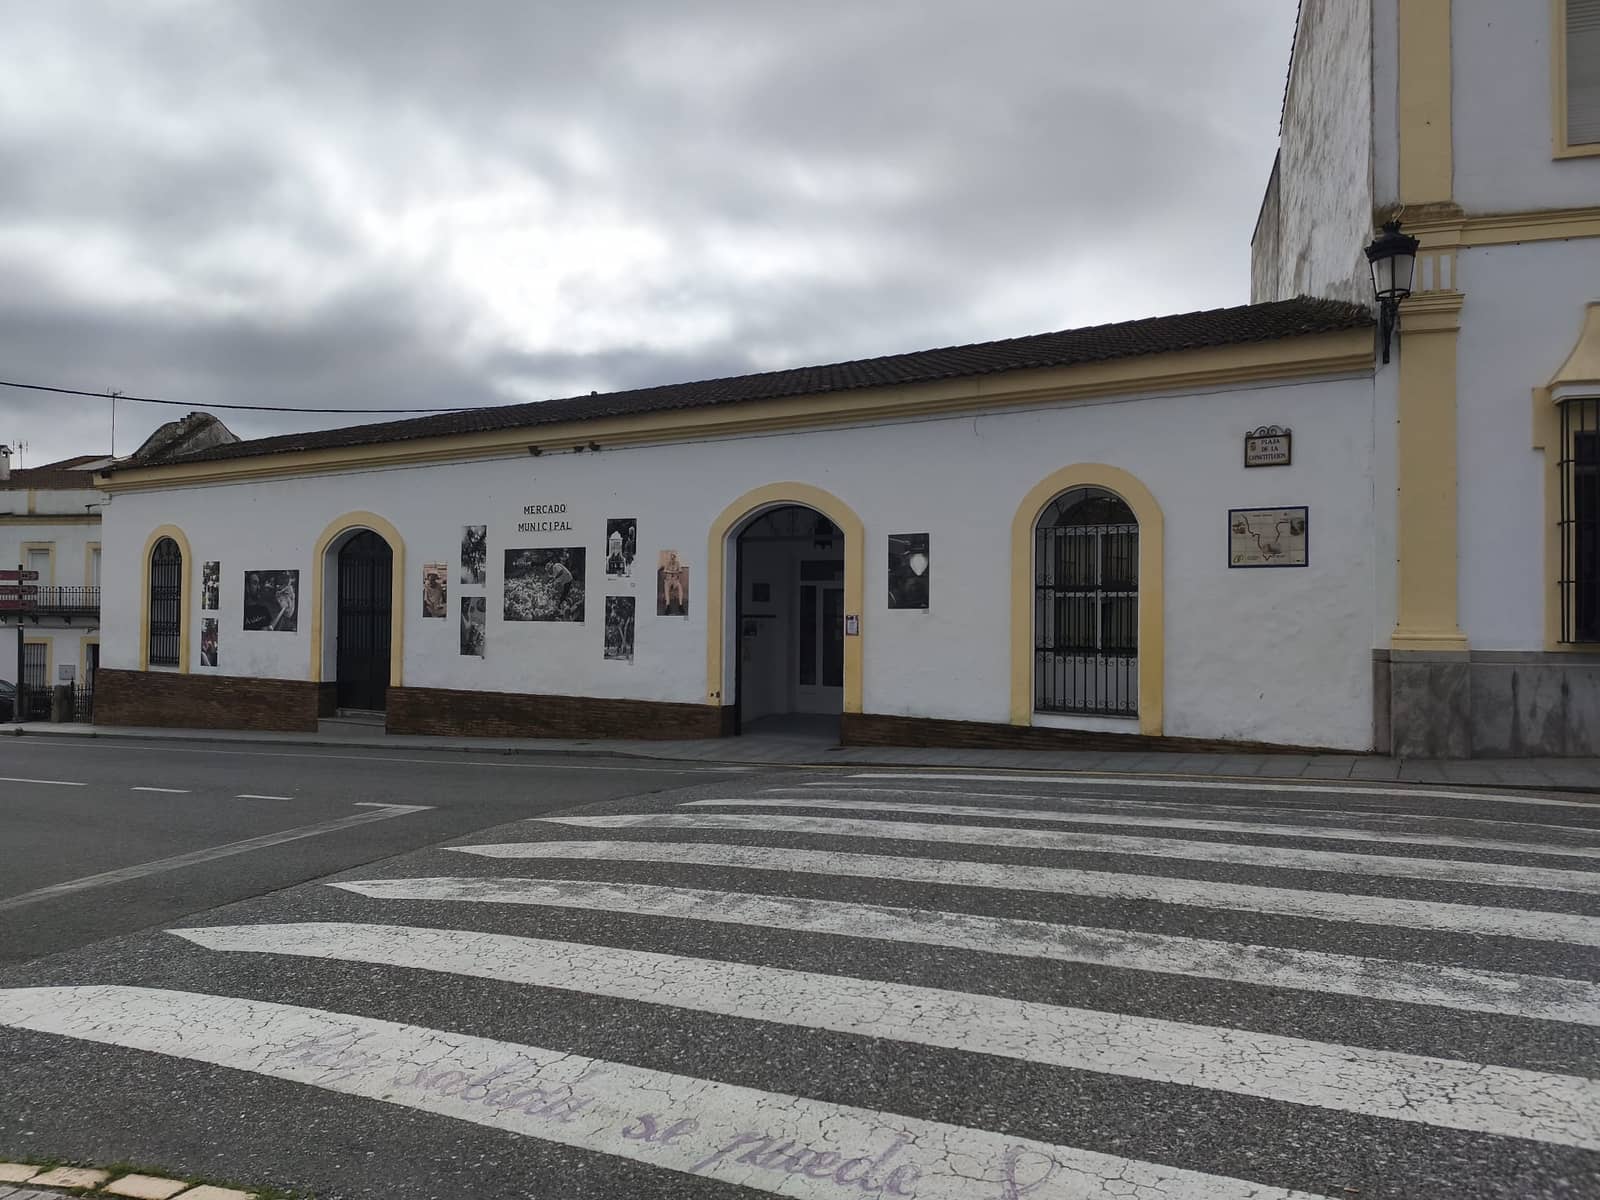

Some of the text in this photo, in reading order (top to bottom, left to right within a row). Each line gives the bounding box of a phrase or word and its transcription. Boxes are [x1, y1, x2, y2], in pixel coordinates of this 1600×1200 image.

[523, 503, 566, 515] MERCADO
[518, 521, 572, 532] MUNICIPAL
[622, 1114, 700, 1144] se
[690, 1132, 923, 1197] puede
